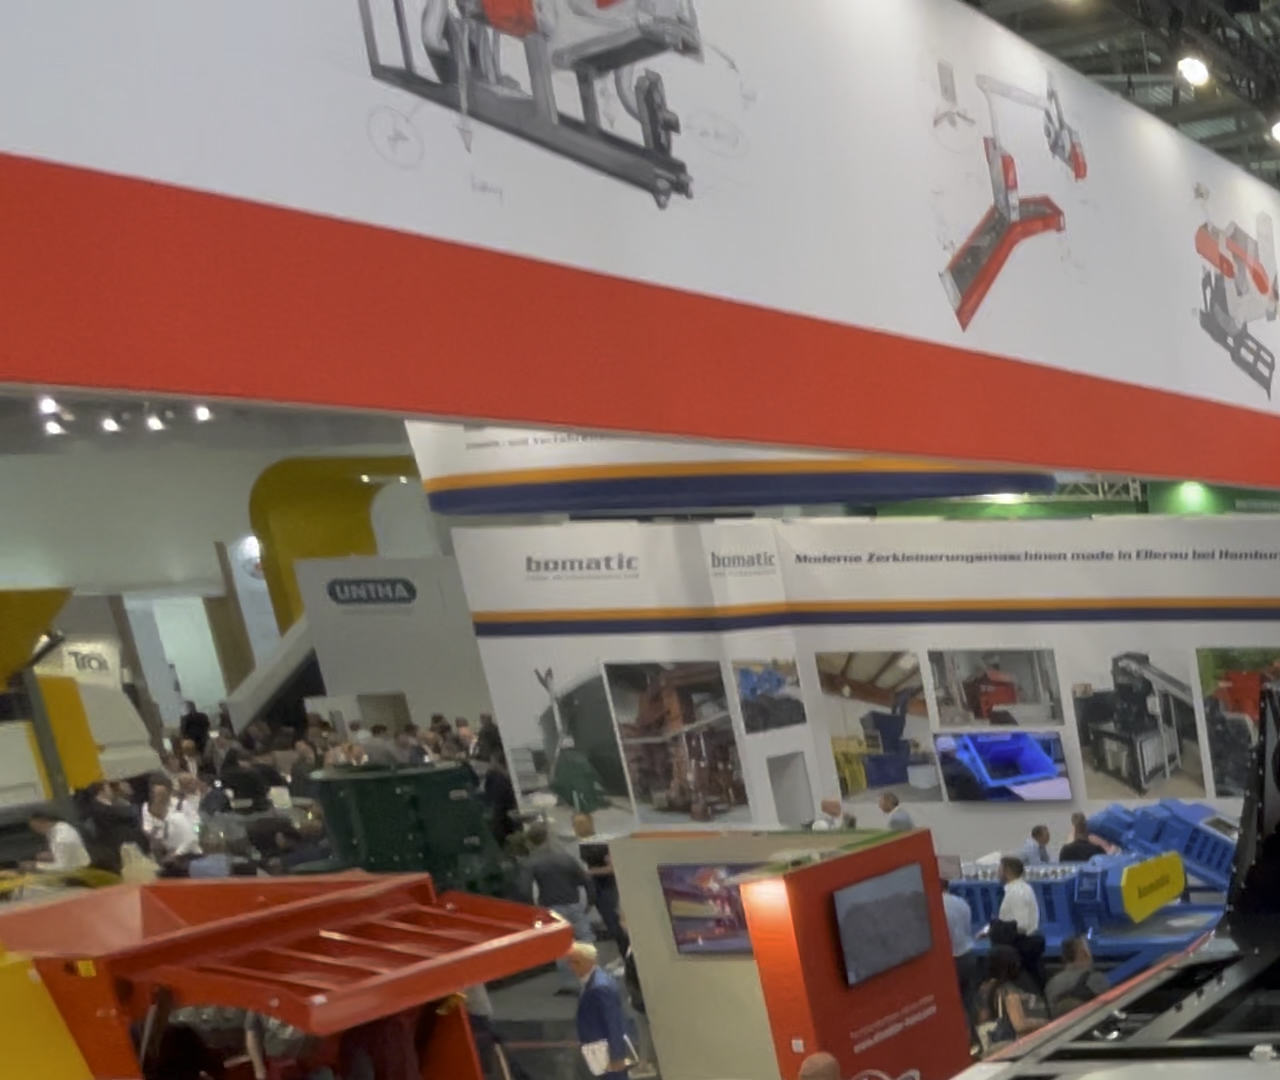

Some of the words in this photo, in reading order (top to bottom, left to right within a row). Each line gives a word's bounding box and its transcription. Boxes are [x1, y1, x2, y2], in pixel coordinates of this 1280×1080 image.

[525, 552, 639, 573] bomatic
[711, 552, 776, 568] bomatic
[1071, 550, 1114, 562] made
